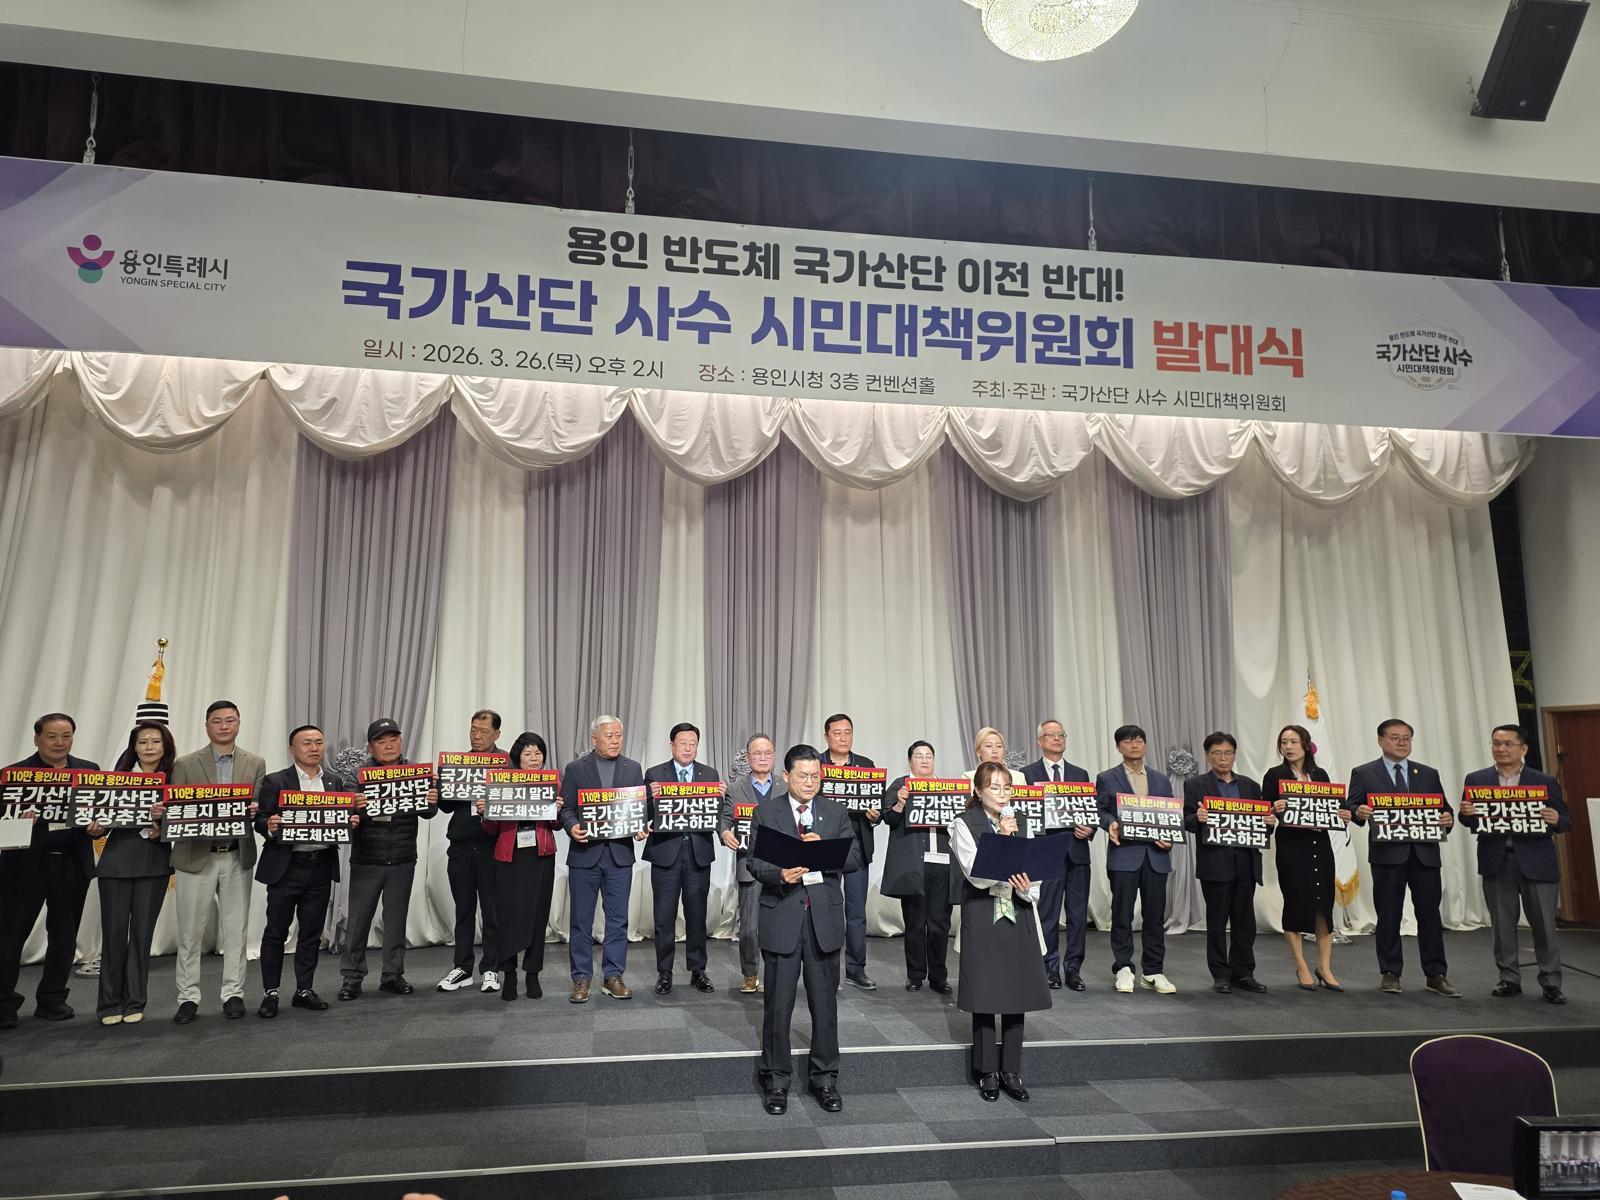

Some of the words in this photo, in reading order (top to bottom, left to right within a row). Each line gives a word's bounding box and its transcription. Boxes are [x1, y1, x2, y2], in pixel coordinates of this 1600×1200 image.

[120, 250, 228, 280] 용인특례시
[567, 226, 648, 269] 용인
[663, 235, 780, 280] 반도체
[793, 245, 947, 292] 국가산단
[958, 258, 1030, 297] 이전
[1042, 264, 1124, 303] 반대!
[120, 277, 158, 287] YONGIN
[160, 280, 201, 290] SPECIAL
[204, 282, 226, 292] CITY
[341, 260, 598, 336] 국가산단
[615, 286, 732, 345] 사수
[750, 296, 1135, 369] 시민대책위원회
[1153, 320, 1305, 379] 발대식
[423, 343, 484, 365] 2026.
[490, 348, 509, 367] 3.
[588, 357, 626, 377] 오후
[632, 360, 664, 379] 2시
[1376, 343, 1441, 362] 국가산단
[1443, 346, 1474, 367] 사수
[1396, 364, 1454, 375] 시민대책위원회
[751, 367, 824, 389] 용인시청
[829, 372, 859, 391] 3층
[865, 374, 936, 395] 컨벤션홀
[1061, 384, 1130, 406] 국가산단
[1135, 388, 1168, 407] 사수
[1173, 389, 1287, 413] 시민대책위원회
[441, 754, 462, 765] 110만
[463, 755, 491, 765] 용인시민
[6, 770, 33, 782] 110만
[34, 771, 71, 782] 용인시민
[77, 773, 105, 785] 110만
[106, 775, 143, 786] 용인시민
[143, 777, 162, 786] 요구
[362, 769, 385, 781] 110만
[386, 768, 416, 779] 용인시민
[416, 767, 431, 776] 요구
[441, 768, 487, 783] 국가산
[489, 772, 511, 783] 110만
[511, 773, 541, 783] 용인시민
[823, 767, 843, 778] 110만
[843, 769, 871, 779] 용인시민
[167, 788, 194, 800] 110만
[195, 787, 230, 799] 용인시민
[364, 779, 431, 799] 국가산단
[441, 783, 486, 799] 정상추
[488, 787, 527, 800] 흔들지
[529, 786, 555, 800] 말라
[679, 785, 706, 796] 용인시민
[822, 781, 857, 795] 흔들지
[859, 783, 884, 796] 말라
[908, 781, 928, 791] 110만
[929, 781, 956, 791] 용인시민
[1281, 782, 1303, 793] 110만
[1303, 783, 1330, 794] 용인시민
[3, 786, 72, 804] 국가산
[75, 790, 159, 808] 국가산단
[282, 793, 305, 805] 110만
[305, 794, 335, 805] 용인시민
[580, 792, 601, 803] 110만
[913, 795, 966, 809] 국가산단
[1120, 796, 1139, 807] 110만
[1370, 796, 1393, 807] 110만
[1393, 797, 1423, 807] 용인시민
[1468, 789, 1492, 800] 110만
[1493, 789, 1526, 799] 용인시민
[166, 803, 213, 820] 흔들지
[217, 801, 248, 818] 말라
[366, 796, 429, 817] 정상추진
[488, 804, 554, 817] 반도체산업
[582, 801, 644, 821] 국가산단
[658, 797, 719, 814] 국가산단
[828, 798, 882, 810] 체산업
[1045, 796, 1098, 811] 국가산단
[1205, 799, 1225, 811] 110만
[1225, 801, 1253, 811] 용인시민
[1287, 796, 1341, 813] 국가산단
[1472, 801, 1546, 818] 국가산단
[0, 803, 69, 820] 사수하
[74, 807, 152, 826] 정상추진
[282, 810, 321, 824] 흔들지
[323, 809, 350, 824] 말라
[1046, 811, 1101, 826] 사수하라
[1121, 811, 1155, 824] 흔들지
[1158, 813, 1181, 826] 말라
[1373, 809, 1442, 825] 국가산단
[586, 819, 645, 838] 사수하라
[659, 814, 719, 830] 사수하라
[1205, 813, 1267, 832] 국가산단
[1476, 817, 1549, 834] 사수하라
[166, 821, 246, 839] 반도체산업
[282, 828, 350, 842] 반도체산업
[1123, 825, 1185, 842] 반도체산업
[1207, 828, 1268, 847] 사수하라
[1377, 824, 1443, 841] 사수하라
